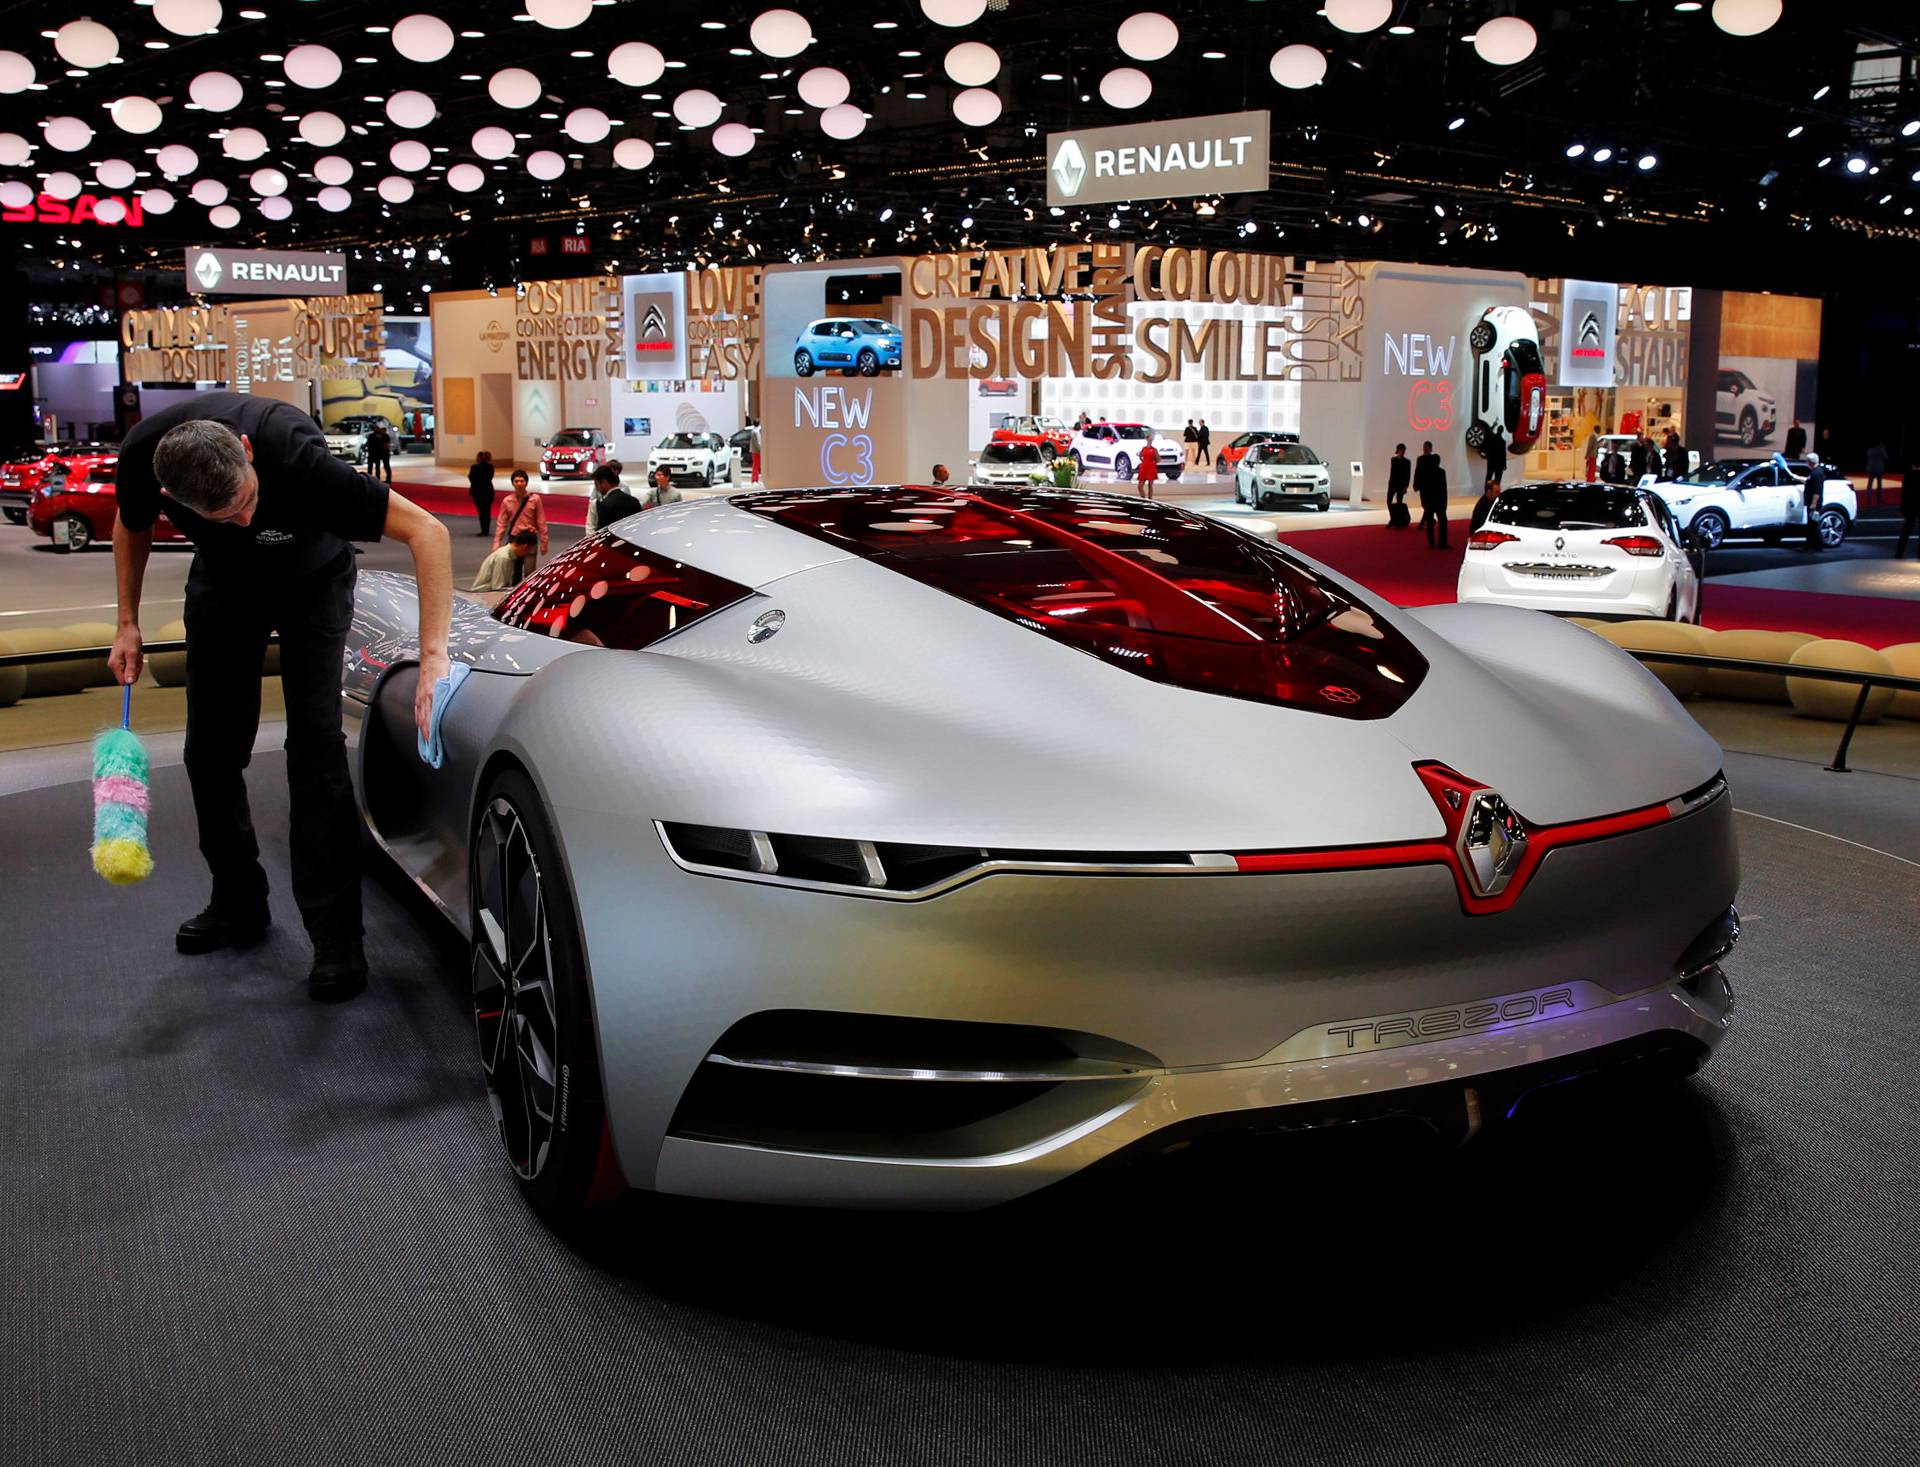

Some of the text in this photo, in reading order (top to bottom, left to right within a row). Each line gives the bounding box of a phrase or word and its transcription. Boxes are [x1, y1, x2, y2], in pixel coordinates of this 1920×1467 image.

[1094, 136, 1252, 177] RENAULT
[564, 239, 587, 252] RIA
[232, 262, 343, 282] RENAULT
[686, 267, 756, 316] LOVE
[911, 246, 1090, 299] CREATIVE
[1135, 246, 1287, 307] COLOUR
[515, 278, 599, 315] POSITIF
[1092, 243, 1132, 381] SHARE
[308, 316, 366, 358] PURE
[516, 316, 600, 337] CONNECTED
[605, 277, 621, 378] SMILE
[910, 301, 1086, 380] DESIGN
[1341, 263, 1365, 382] EASY
[162, 350, 226, 381] POSITIF
[516, 340, 600, 380] ENERGY
[689, 343, 758, 380] EASY
[1136, 317, 1286, 383] SMILE
[1384, 332, 1456, 376] NEW
[1616, 336, 1687, 386] SHARE
[795, 386, 873, 429] NEW
[1408, 380, 1455, 431] C3
[821, 433, 874, 486] C3
[1533, 572, 1583, 581] RENAULT
[561, 1064, 569, 1126] Continental
